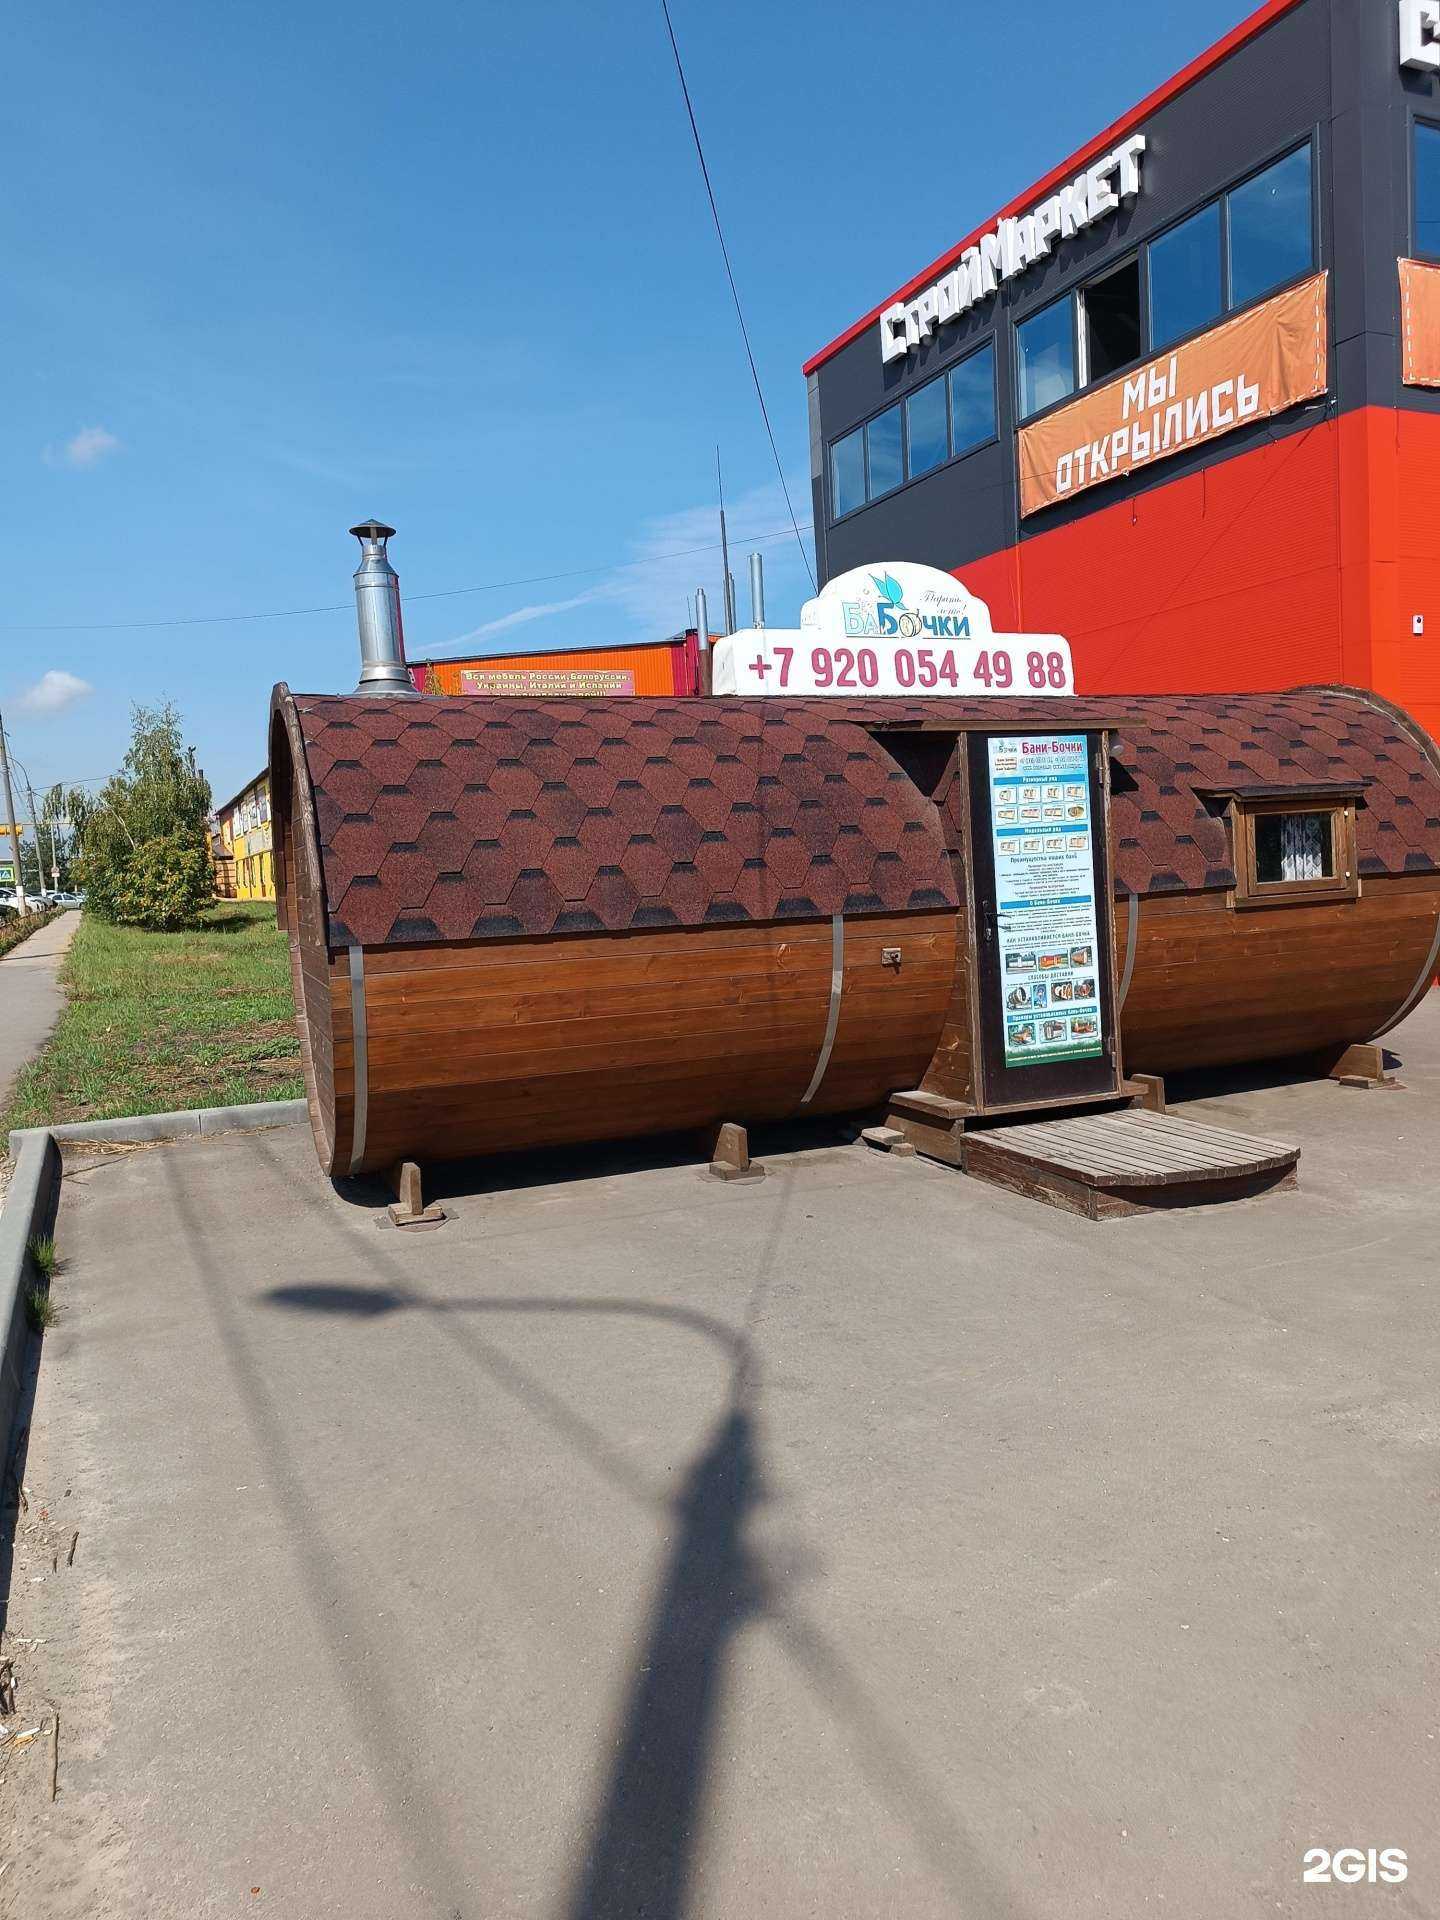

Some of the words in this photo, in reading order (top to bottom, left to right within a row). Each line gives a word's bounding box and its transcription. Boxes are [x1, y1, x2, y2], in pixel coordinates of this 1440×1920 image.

[1122, 355, 1178, 420] МЫ
[1056, 374, 1260, 493] ОТКРЫЛИСЬ
[748, 647, 794, 687] +7
[811, 648, 879, 687] 920
[894, 648, 959, 688] 054
[973, 650, 1012, 688] 49
[1027, 651, 1066, 689] 88
[1022, 741, 1083, 754] Бани-Бочки
